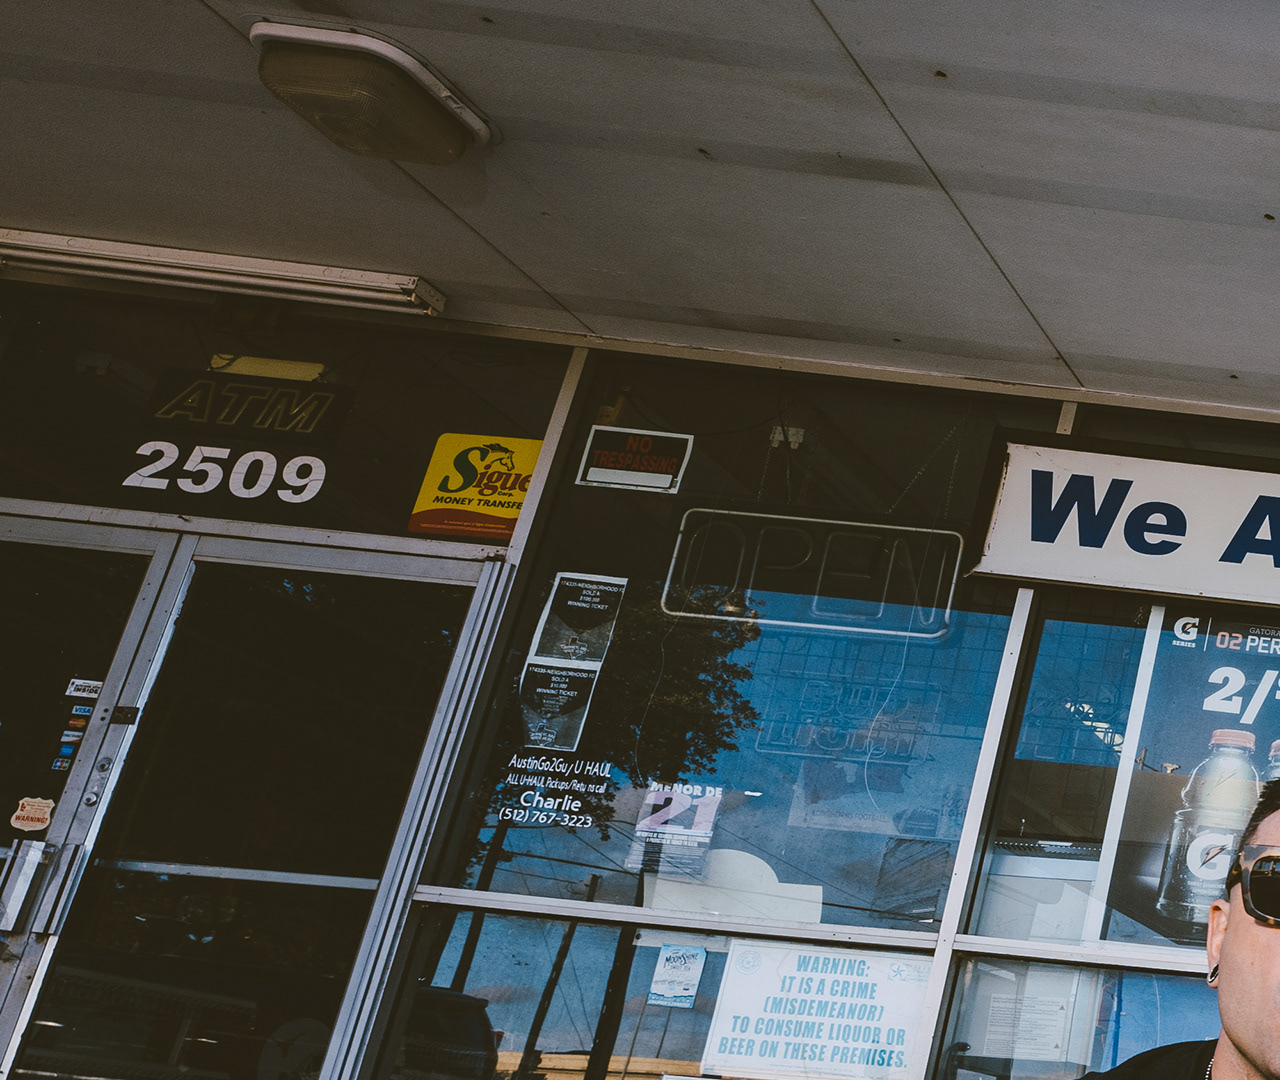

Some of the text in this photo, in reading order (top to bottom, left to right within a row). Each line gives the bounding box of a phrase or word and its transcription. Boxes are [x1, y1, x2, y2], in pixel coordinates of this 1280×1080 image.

[154, 379, 335, 434] ATM
[625, 434, 653, 453] NO
[122, 440, 328, 504] 2509
[438, 446, 533, 497] Sigue
[592, 450, 678, 473] TRESPASSING
[433, 495, 523, 510] MONEY TRANSFE
[1029, 469, 1189, 557] We
[681, 521, 950, 628] OPEN
[1171, 639, 1196, 648] SERIES
[1216, 631, 1243, 650] 02
[536, 687, 577, 697] WINNING TICKET
[74, 707, 92, 715] VISA
[584, 761, 612, 778] HAUL
[505, 773, 608, 794] ALL U-HAUL call
[650, 781, 723, 797] MENOR DE
[520, 790, 582, 812] Charlie
[635, 790, 722, 831] 21
[14, 814, 49, 825] WARNING!
[498, 807, 593, 828] (512) 767-3223
[796, 954, 870, 978] WARNING:
[780, 975, 878, 1000] IT IS A CRIME
[763, 995, 885, 1023] (MISDEMEANOR)
[731, 1015, 907, 1046] TO CONSUME LIQUOR OR
[718, 1036, 756, 1057] BEER
[758, 1040, 779, 1058] ON
[782, 1041, 827, 1062] THESE
[830, 1045, 908, 1069] PREMISES.
